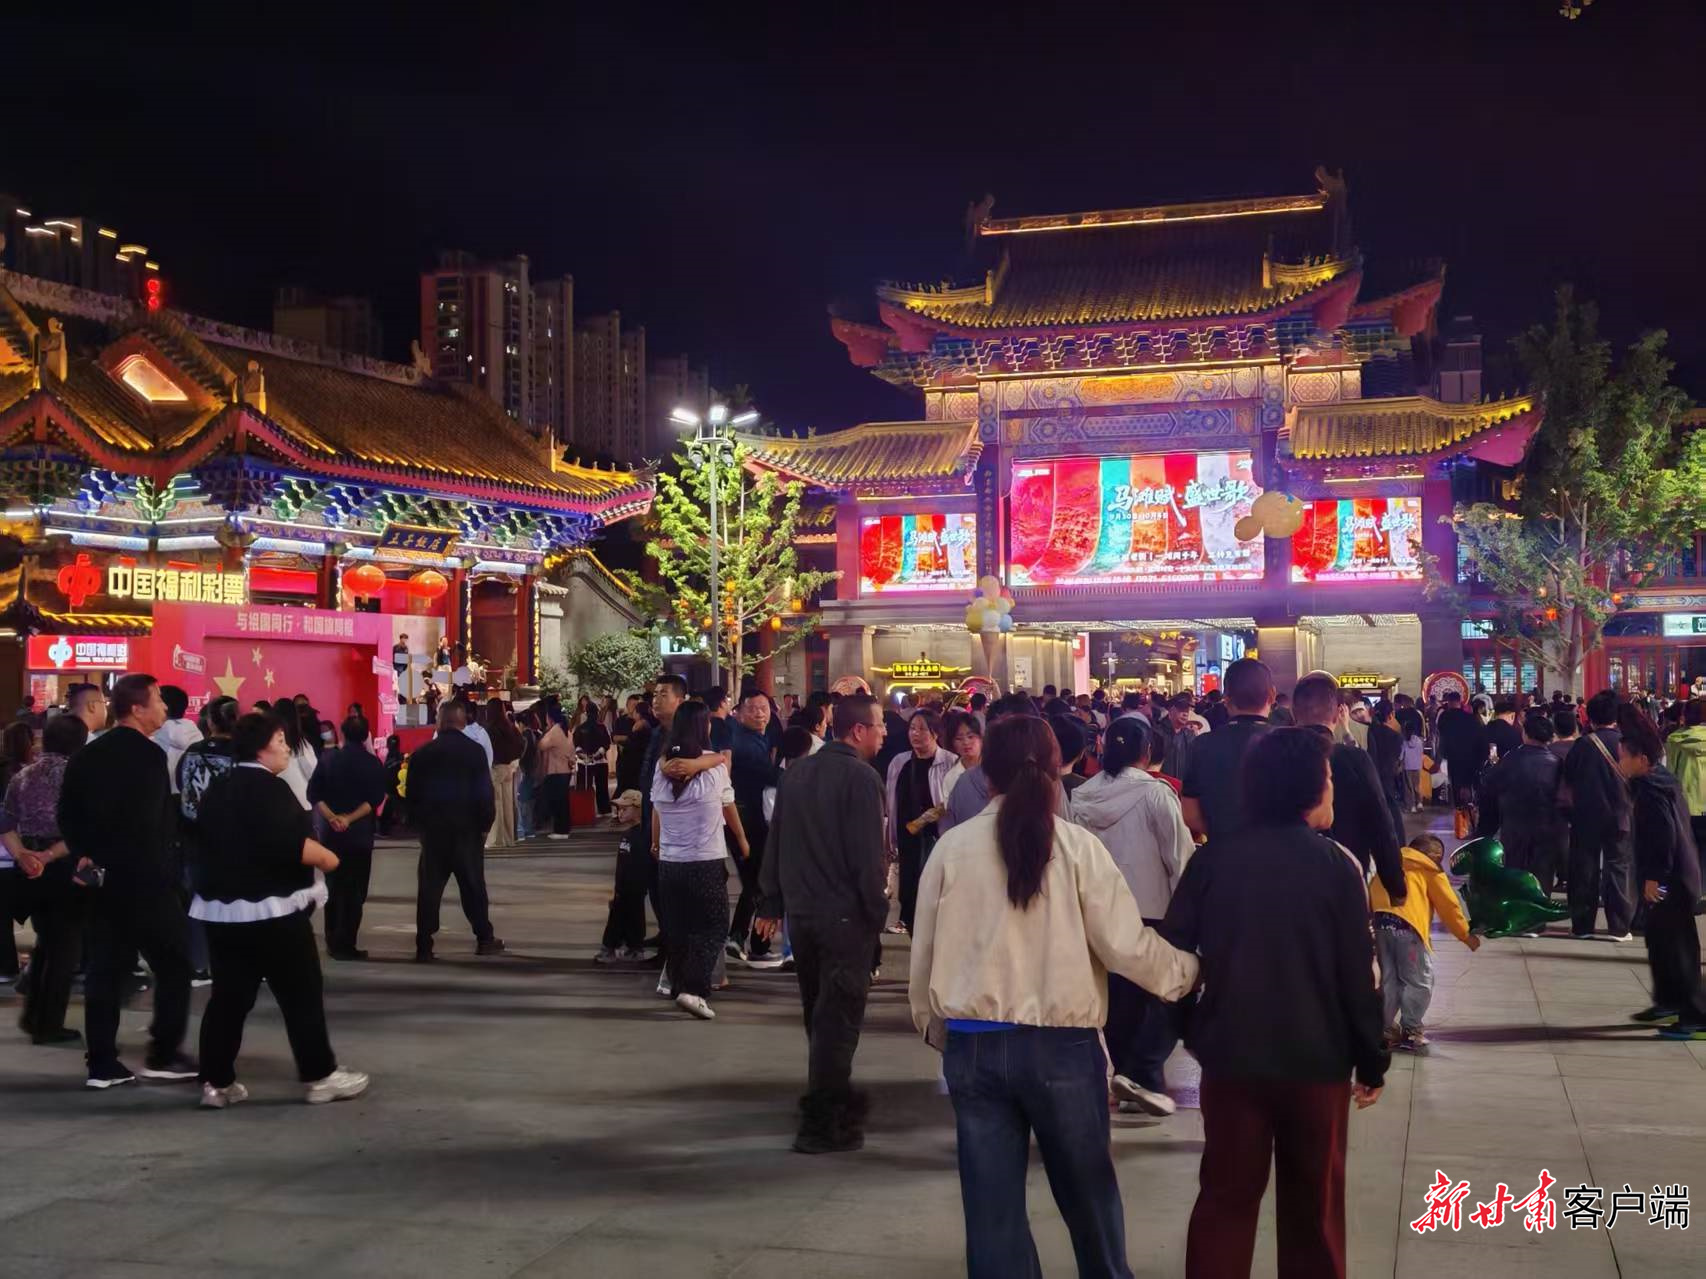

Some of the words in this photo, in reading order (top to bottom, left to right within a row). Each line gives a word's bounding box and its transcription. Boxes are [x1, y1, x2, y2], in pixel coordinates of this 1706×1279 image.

[108, 565, 245, 605] 中国福利彩票
